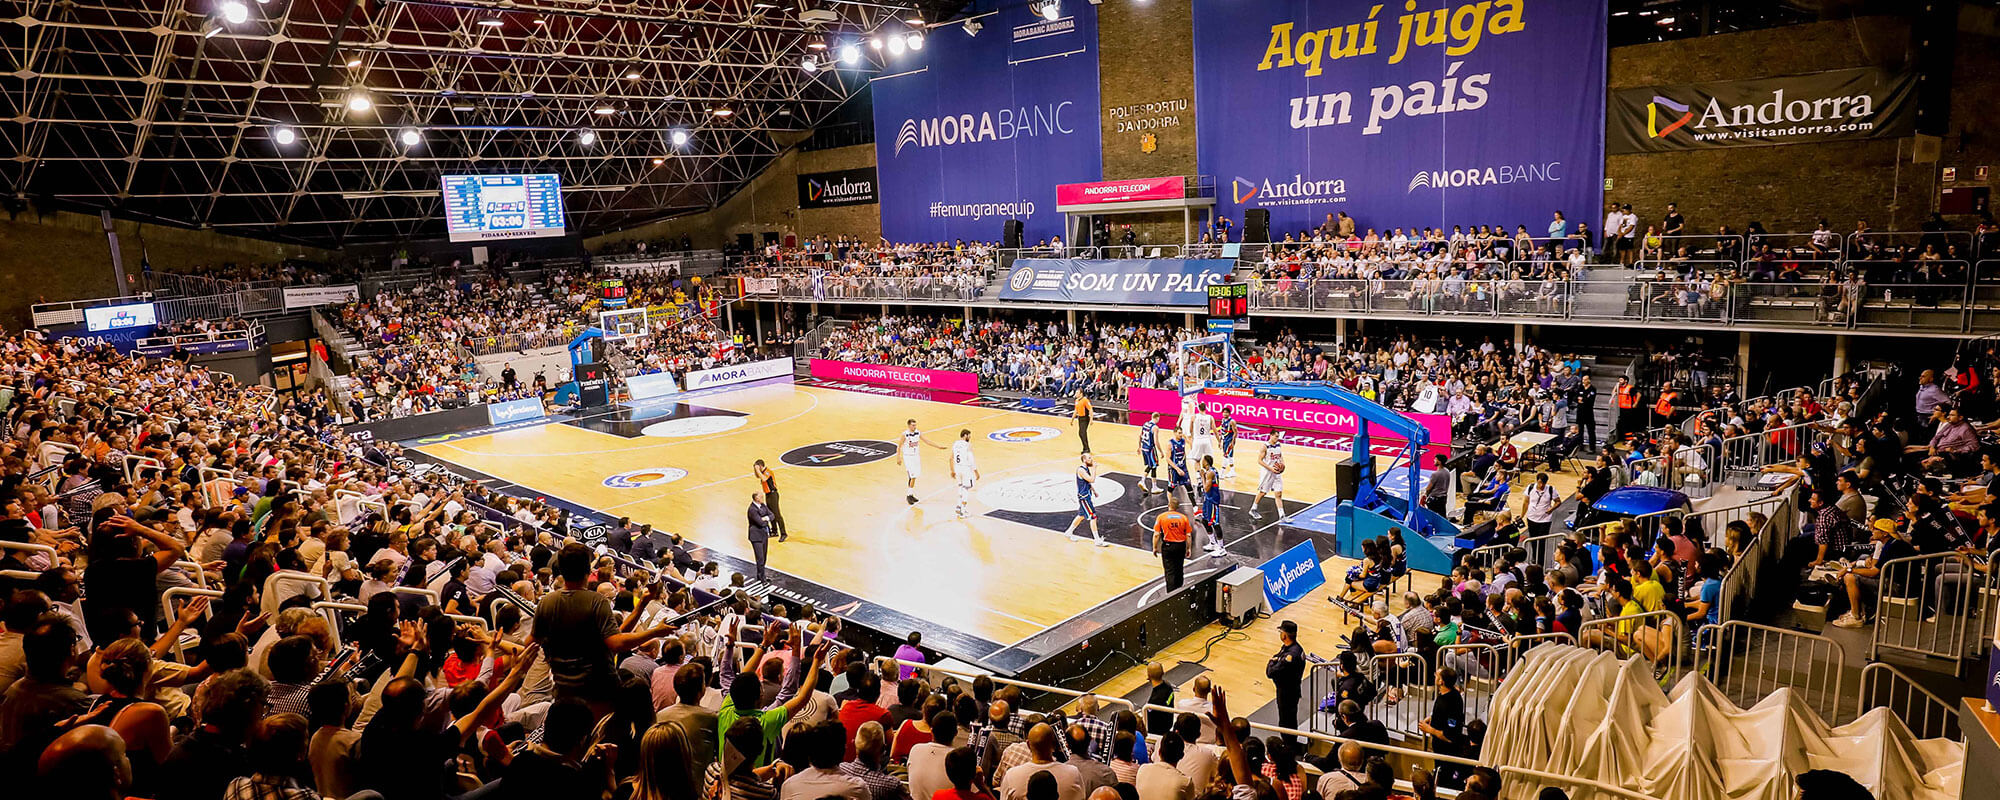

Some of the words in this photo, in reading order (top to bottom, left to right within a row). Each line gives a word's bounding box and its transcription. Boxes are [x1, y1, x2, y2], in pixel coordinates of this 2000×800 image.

[1257, 4, 1384, 77] Aquí
[1388, 0, 1526, 65] juga
[1290, 91, 1352, 129] un
[1363, 61, 1491, 135] país
[1110, 99, 1187, 119] POLIESPORTIU
[1694, 88, 1874, 129] Andorra
[920, 101, 1074, 147] MORABANC
[1117, 115, 1180, 133] D'ANDORRA
[1694, 122, 1873, 141] www.visitandorra.com
[1431, 162, 1561, 188] MORABANC
[823, 177, 872, 197] Andorra
[1084, 186, 1117, 195] ANDORRA
[1119, 184, 1151, 192] TELECOM
[1258, 174, 1346, 198] Andorra
[929, 199, 1035, 221] #femungranequip
[1258, 196, 1346, 206] www.visitandorra.com
[491, 215, 523, 228] 03:06
[1066, 272, 1119, 292] SOM
[1122, 273, 1161, 292] UN
[1162, 269, 1222, 293] PAÍS
[1209, 286, 1231, 296] 03:06
[1216, 298, 1230, 315] 14
[843, 366, 886, 379] ANDORRA
[888, 371, 931, 383] TELECOM
[1423, 389, 1432, 399] 10
[1271, 407, 1354, 427] TELECOM
[587, 526, 602, 538] KIA
[453, 590, 462, 599] 3
